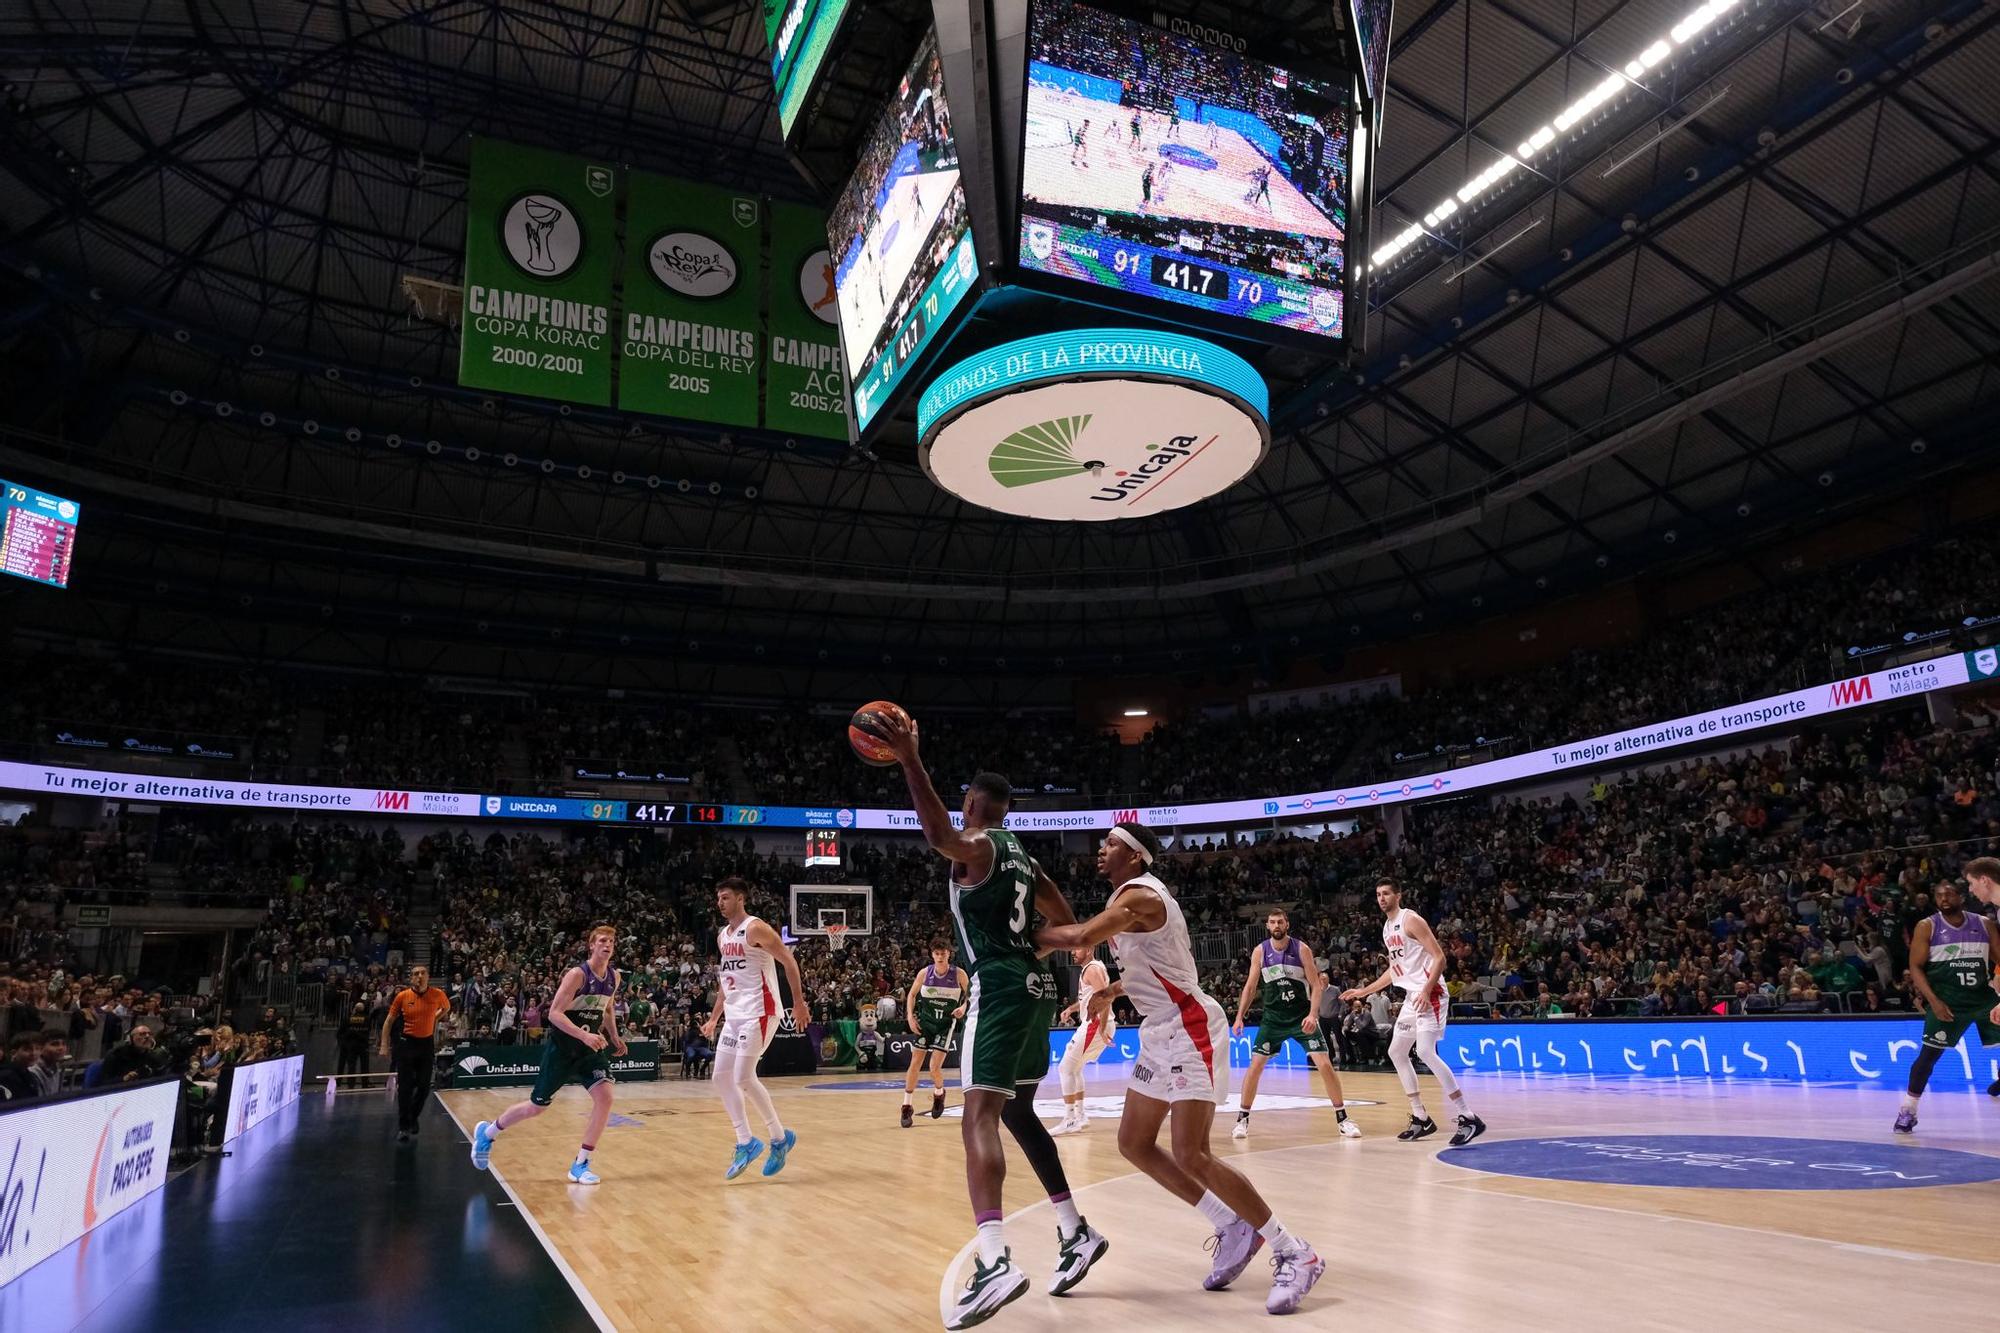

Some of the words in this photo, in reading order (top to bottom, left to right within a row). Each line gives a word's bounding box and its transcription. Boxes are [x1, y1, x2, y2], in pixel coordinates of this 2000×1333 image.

[1171, 17, 1247, 53] MONDO
[661, 251, 702, 276] Rey
[672, 246, 710, 266] Copa
[1114, 249, 1140, 275] 91
[1163, 263, 1213, 295] 41.7
[1237, 279, 1262, 304] 70
[469, 285, 607, 335] CAMPEONES
[925, 293, 938, 323] 70
[475, 316, 529, 340] COPA
[535, 326, 600, 351] KORAC
[626, 312, 754, 359] CAMPEONES
[899, 319, 919, 360] 41.7
[492, 345, 584, 375] 2000/2001
[624, 341, 674, 363] COPA
[679, 349, 714, 369] DEL
[720, 355, 755, 375] REY
[772, 336, 841, 373] CAMPE
[1006, 352, 1033, 378] DE
[1042, 350, 1070, 369] LA
[1079, 343, 1205, 374] PROVINCIA
[883, 355, 893, 383] 91
[669, 373, 710, 394] 2005
[805, 370, 841, 396] AC
[790, 391, 844, 414] 2005/2
[1090, 434, 1198, 502] Unicaja
[9, 488, 26, 501] 70
[1888, 663, 1936, 681] metro
[1890, 676, 1940, 695] Málaga
[1552, 751, 1567, 766] Tu
[1570, 742, 1609, 762] mejor
[1613, 724, 1694, 752] alternativa
[1698, 718, 1717, 734] de
[1721, 698, 1806, 729] transporte
[44, 771, 65, 787] Tu
[71, 774, 129, 794] mejor
[134, 780, 235, 800] alternativa
[240, 788, 262, 802] de
[267, 789, 352, 808] transporte
[423, 793, 460, 803] metro
[422, 802, 460, 815] Málaga
[510, 803, 557, 814] UNICAJA
[591, 805, 613, 820] 91
[635, 806, 676, 822] 41.7
[699, 808, 716, 821] 14
[738, 809, 758, 824] 70
[1148, 808, 1178, 816] metro
[1265, 803, 1277, 814] L2
[887, 814, 900, 825] Tu
[1015, 815, 1029, 827] de
[1033, 815, 1095, 830] transporte
[1149, 816, 1178, 826] Málaga
[817, 831, 836, 840] 41.7
[817, 841, 837, 857] 14
[1009, 880, 1028, 933] 3
[722, 960, 747, 972] ATC
[1950, 960, 1980, 968] málaga
[726, 976, 736, 990] 2
[1956, 972, 1978, 986] 15
[1281, 990, 1296, 1002] 45
[486, 1063, 522, 1075] Unicaja
[522, 1063, 541, 1073] Ban
[609, 1060, 627, 1070] caja
[628, 1060, 655, 1069] Banco
[1585, 1151, 1749, 1171] HOTEL
[110, 1156, 135, 1197] PACO
[133, 1146, 155, 1183] PEPE
